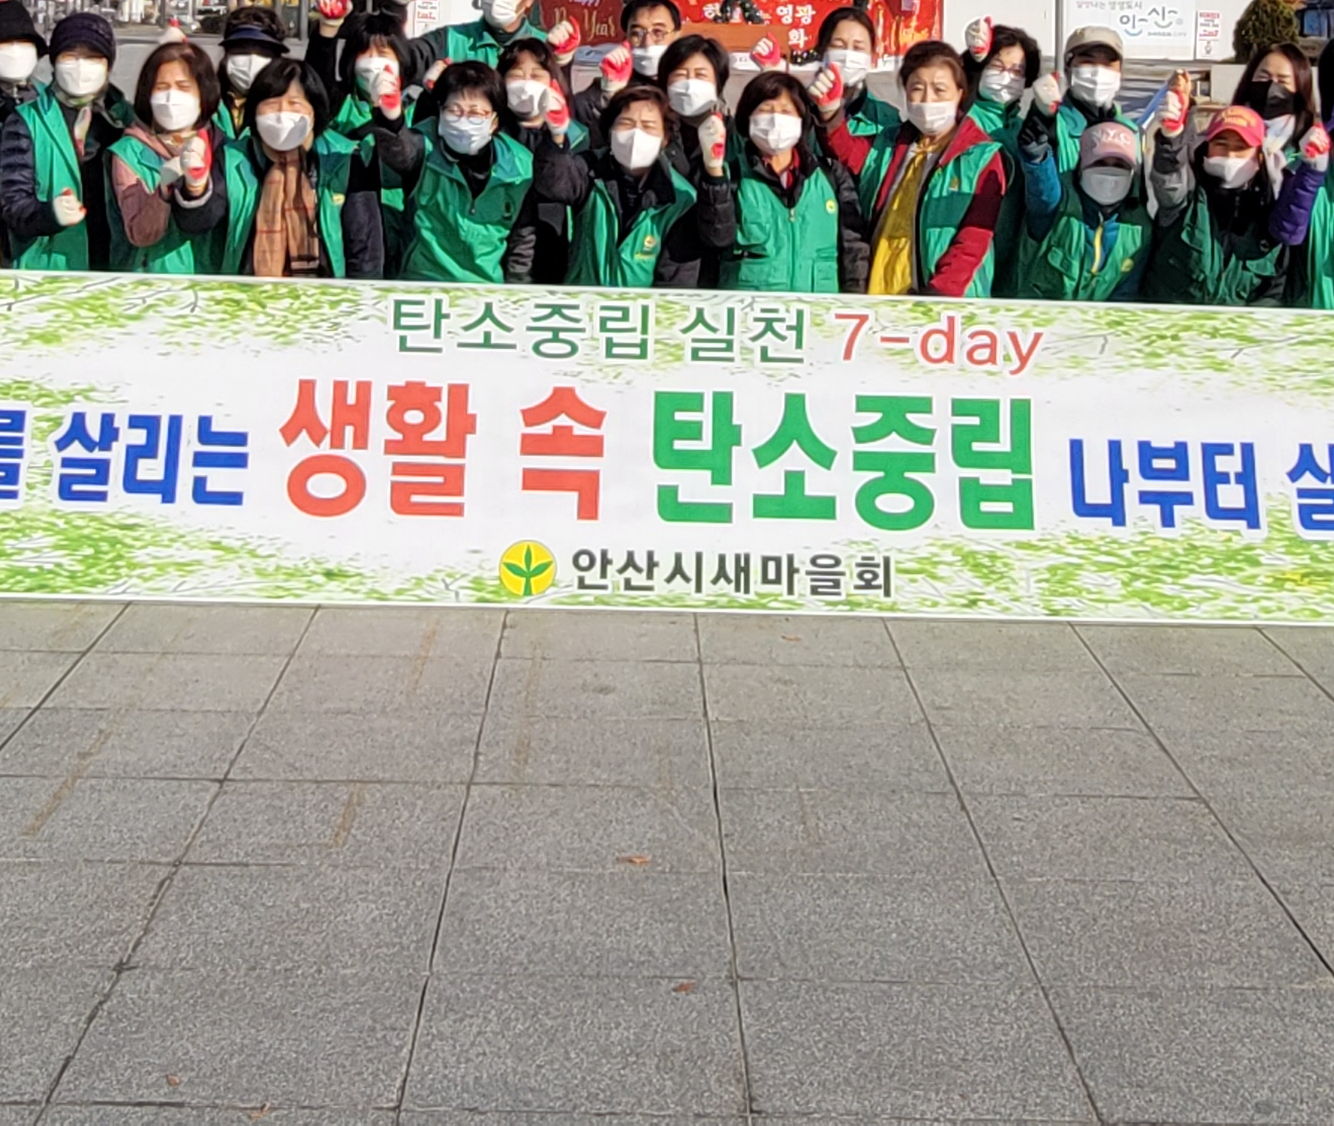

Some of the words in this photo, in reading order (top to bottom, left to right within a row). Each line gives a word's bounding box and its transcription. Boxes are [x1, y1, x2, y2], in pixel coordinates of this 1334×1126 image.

[392, 297, 651, 361] 탄소중립
[678, 305, 809, 366] 실천
[834, 311, 1045, 375] 7-day
[54, 409, 251, 507] 살리는
[279, 376, 478, 519] 생활
[519, 384, 607, 523] 속
[651, 389, 1038, 533] 탄소중립
[1069, 437, 1267, 531] 나부터
[570, 545, 896, 600] 안산시새마을회
